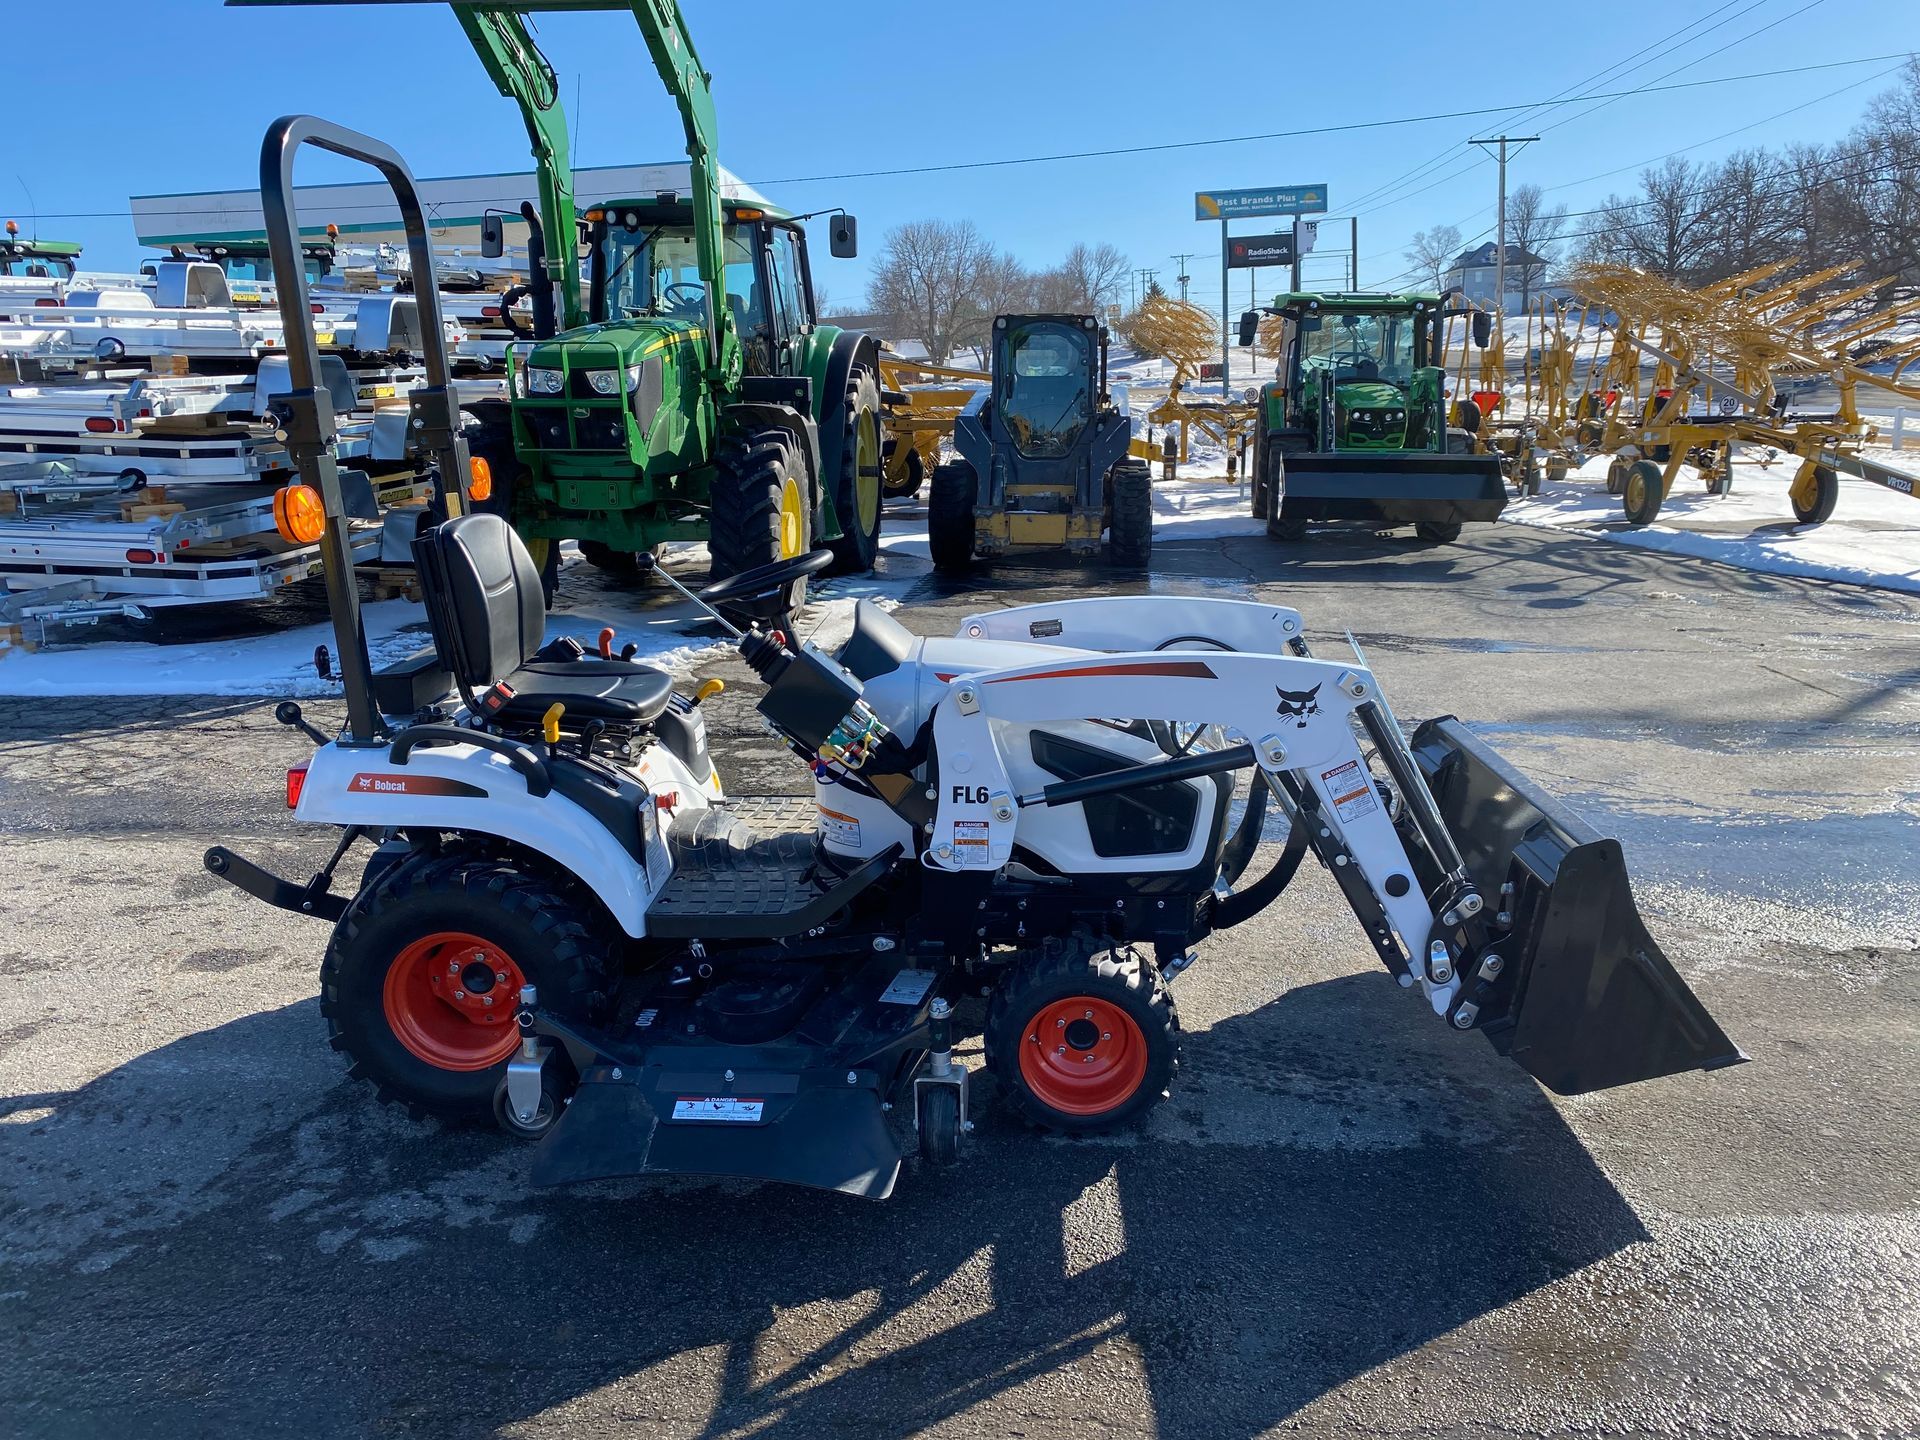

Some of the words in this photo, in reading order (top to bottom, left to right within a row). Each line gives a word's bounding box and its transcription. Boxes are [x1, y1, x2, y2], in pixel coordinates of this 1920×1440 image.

[1217, 198, 1237, 206] Best
[1241, 196, 1273, 204] Brands
[1277, 194, 1296, 203] Plus
[1248, 247, 1289, 256] RadioShack
[1724, 398, 1735, 406] 20
[1887, 475, 1912, 492] VR1224
[1330, 762, 1355, 776] DANGER
[374, 780, 406, 791] Bobcat
[952, 786, 989, 804] FL6
